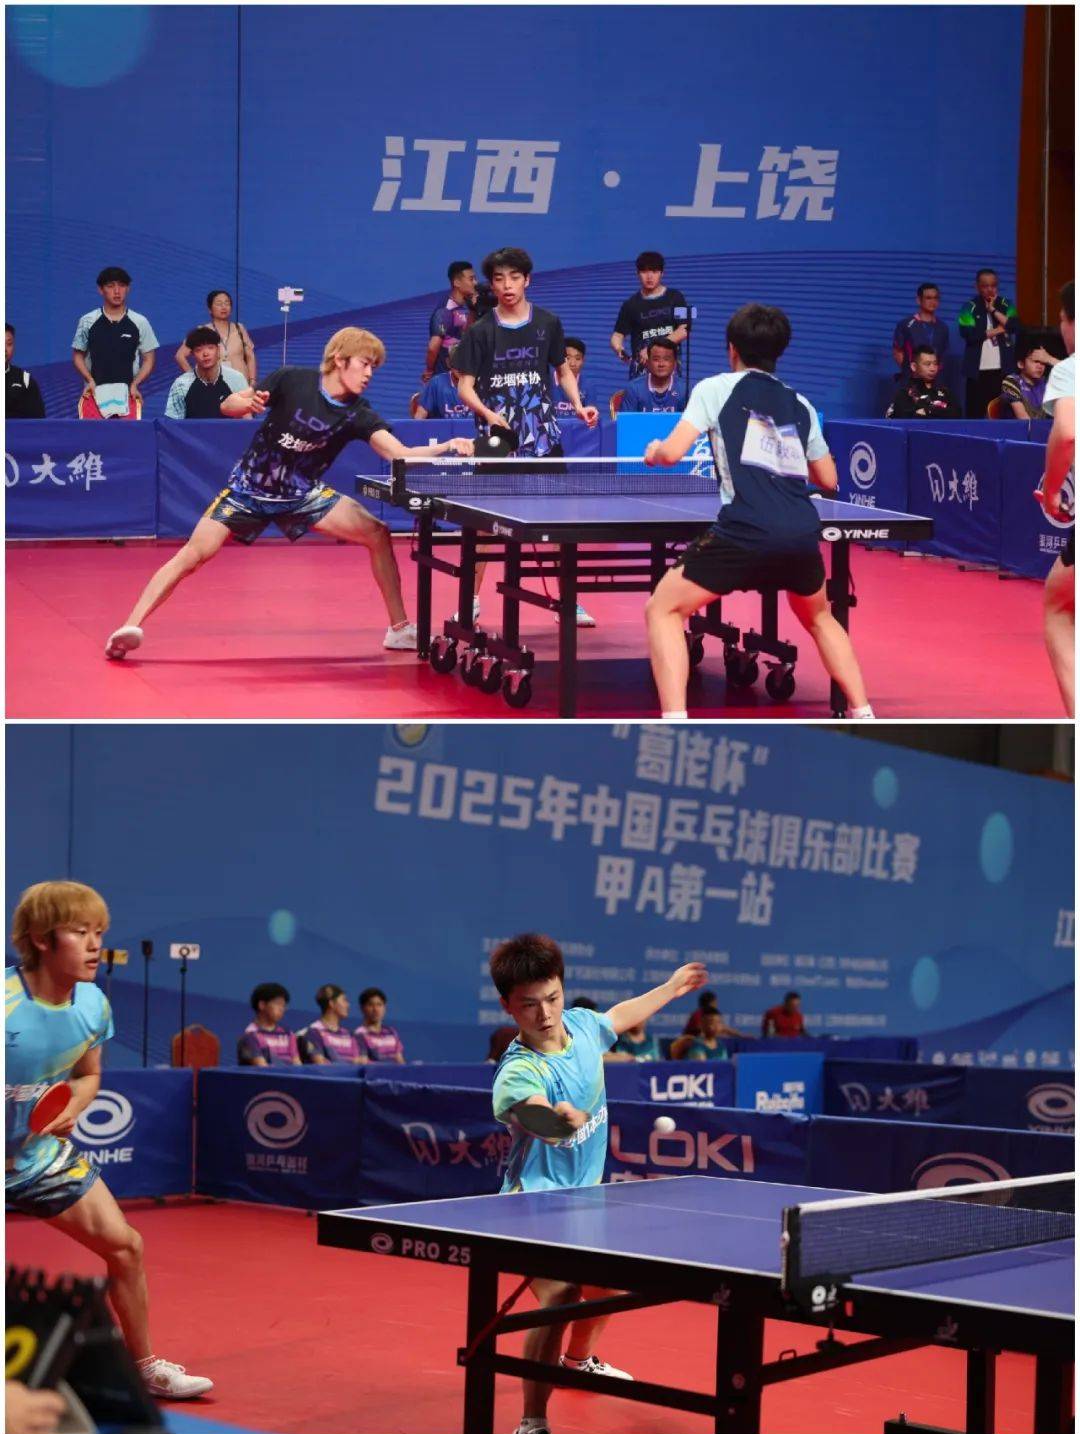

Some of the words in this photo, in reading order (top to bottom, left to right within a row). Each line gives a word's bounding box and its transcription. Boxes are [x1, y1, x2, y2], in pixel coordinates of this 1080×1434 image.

[493, 347, 534, 361] LOKI
[843, 529, 889, 539] YINHE
[375, 755, 921, 884] 2025年中国乒乓球俱乐部比赛
[595, 856, 775, 926] 甲A第一站
[650, 1074, 713, 1102] LOKI
[80, 1148, 134, 1164] INHE
[611, 1125, 754, 1173] LOKI
[401, 1238, 439, 1258] PRO
[448, 1246, 471, 1264] 25
